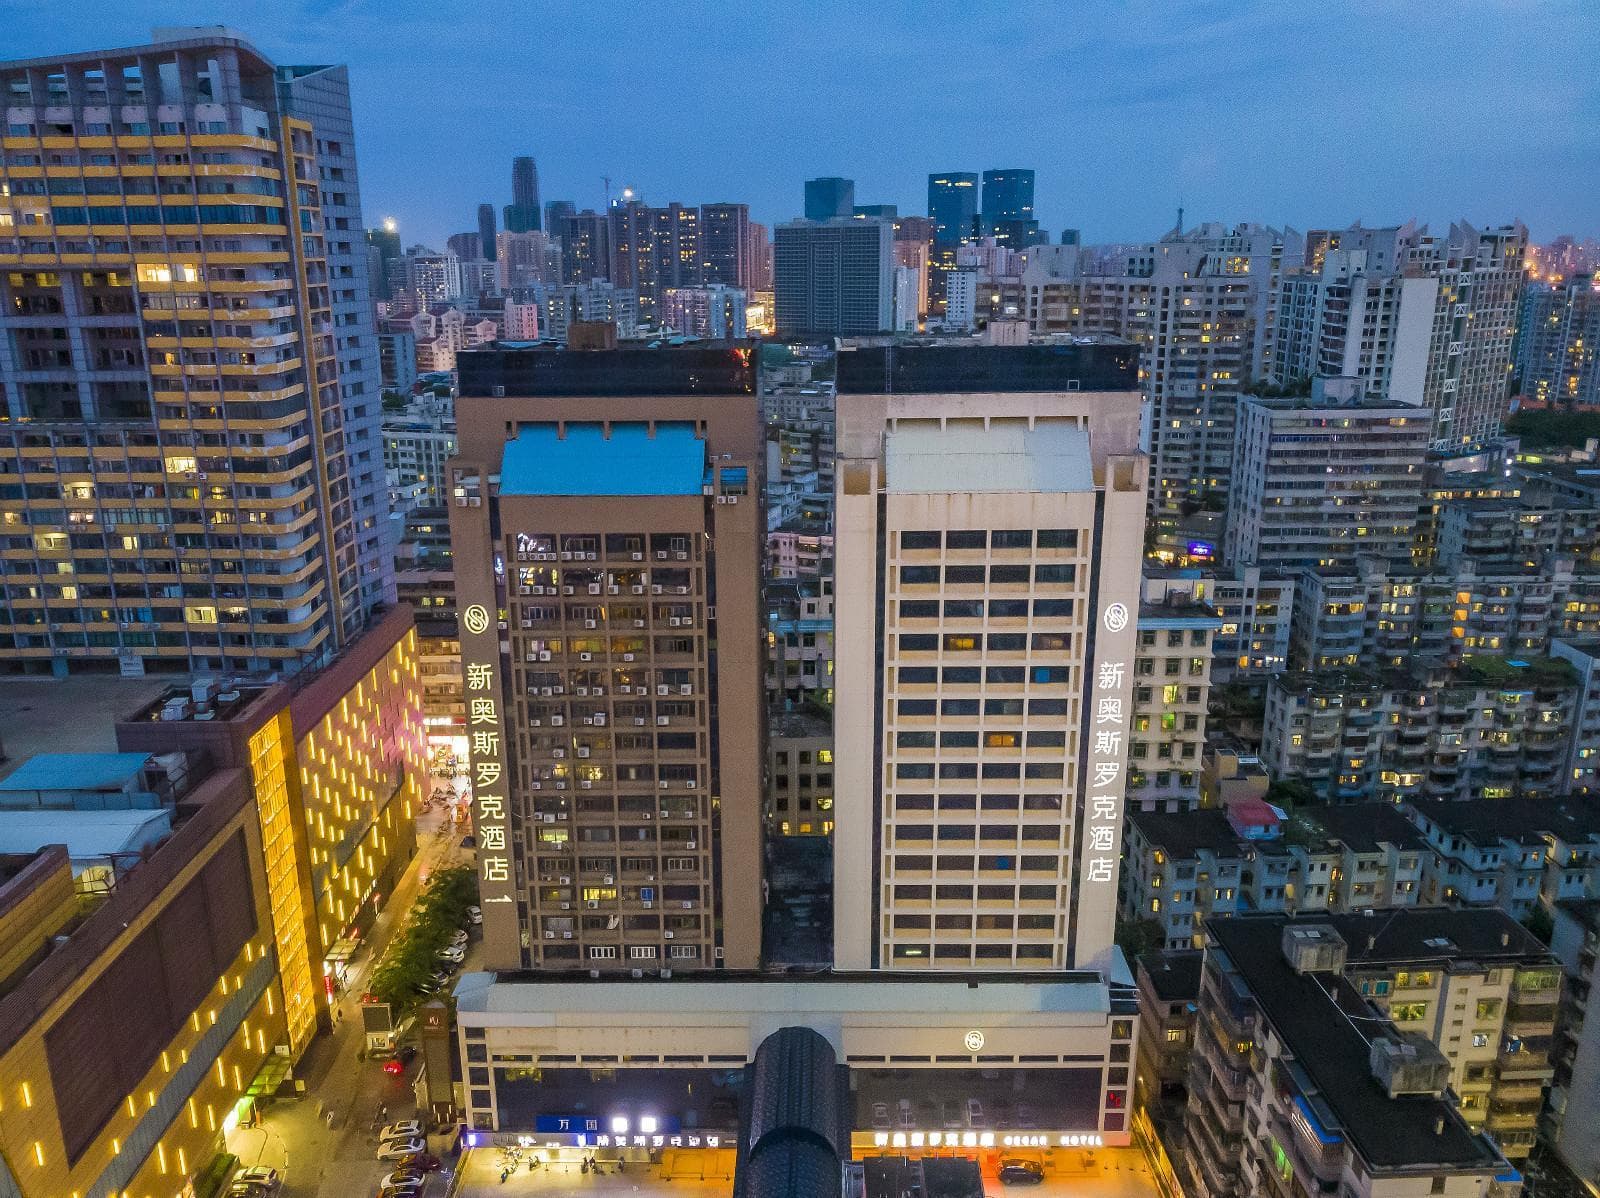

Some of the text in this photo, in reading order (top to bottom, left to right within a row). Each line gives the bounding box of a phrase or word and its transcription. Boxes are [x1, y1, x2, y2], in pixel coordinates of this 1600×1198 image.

[1087, 662, 1125, 882] 新奥斯罗克酒店
